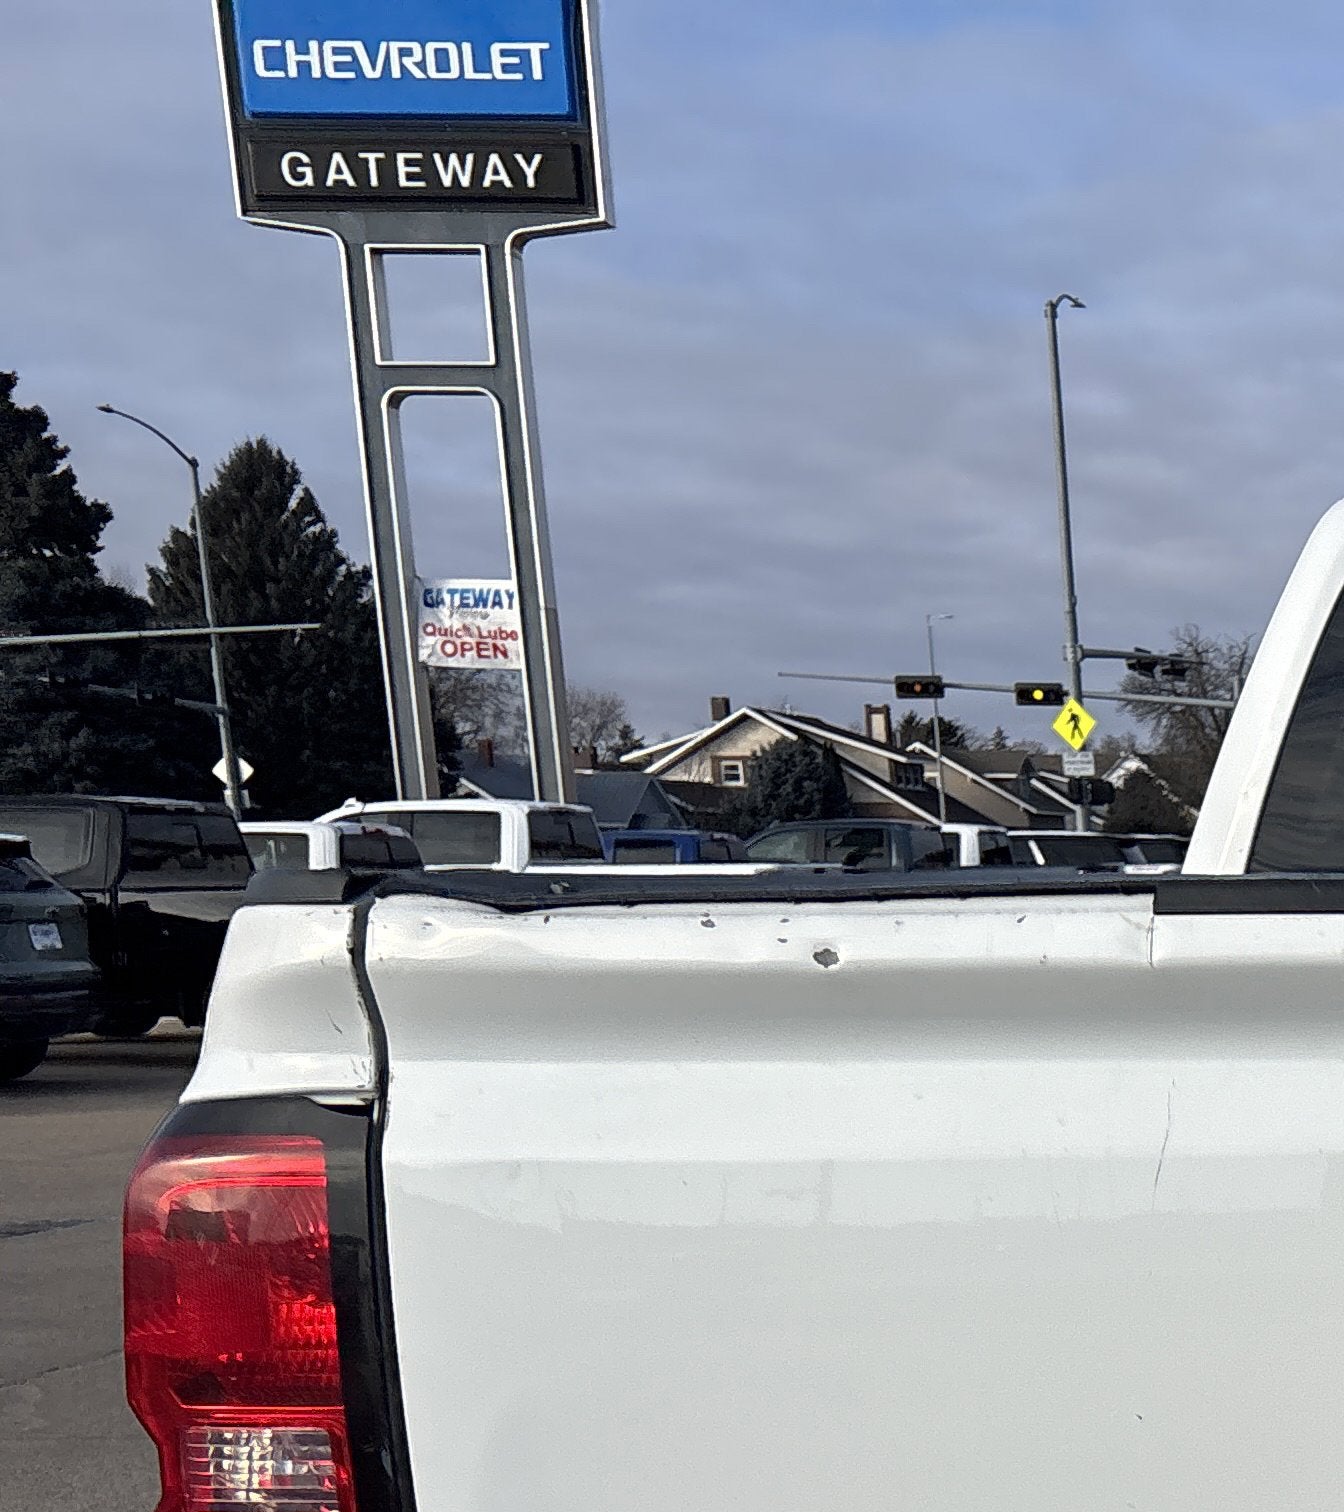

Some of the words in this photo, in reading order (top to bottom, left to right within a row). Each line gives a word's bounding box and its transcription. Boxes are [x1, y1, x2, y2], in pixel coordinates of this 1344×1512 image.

[252, 39, 550, 81] CHEVROLET
[280, 151, 544, 189] GATEWAY
[423, 587, 515, 610] GATEWAY
[477, 625, 519, 641] Lube
[440, 640, 510, 659] OPEN
